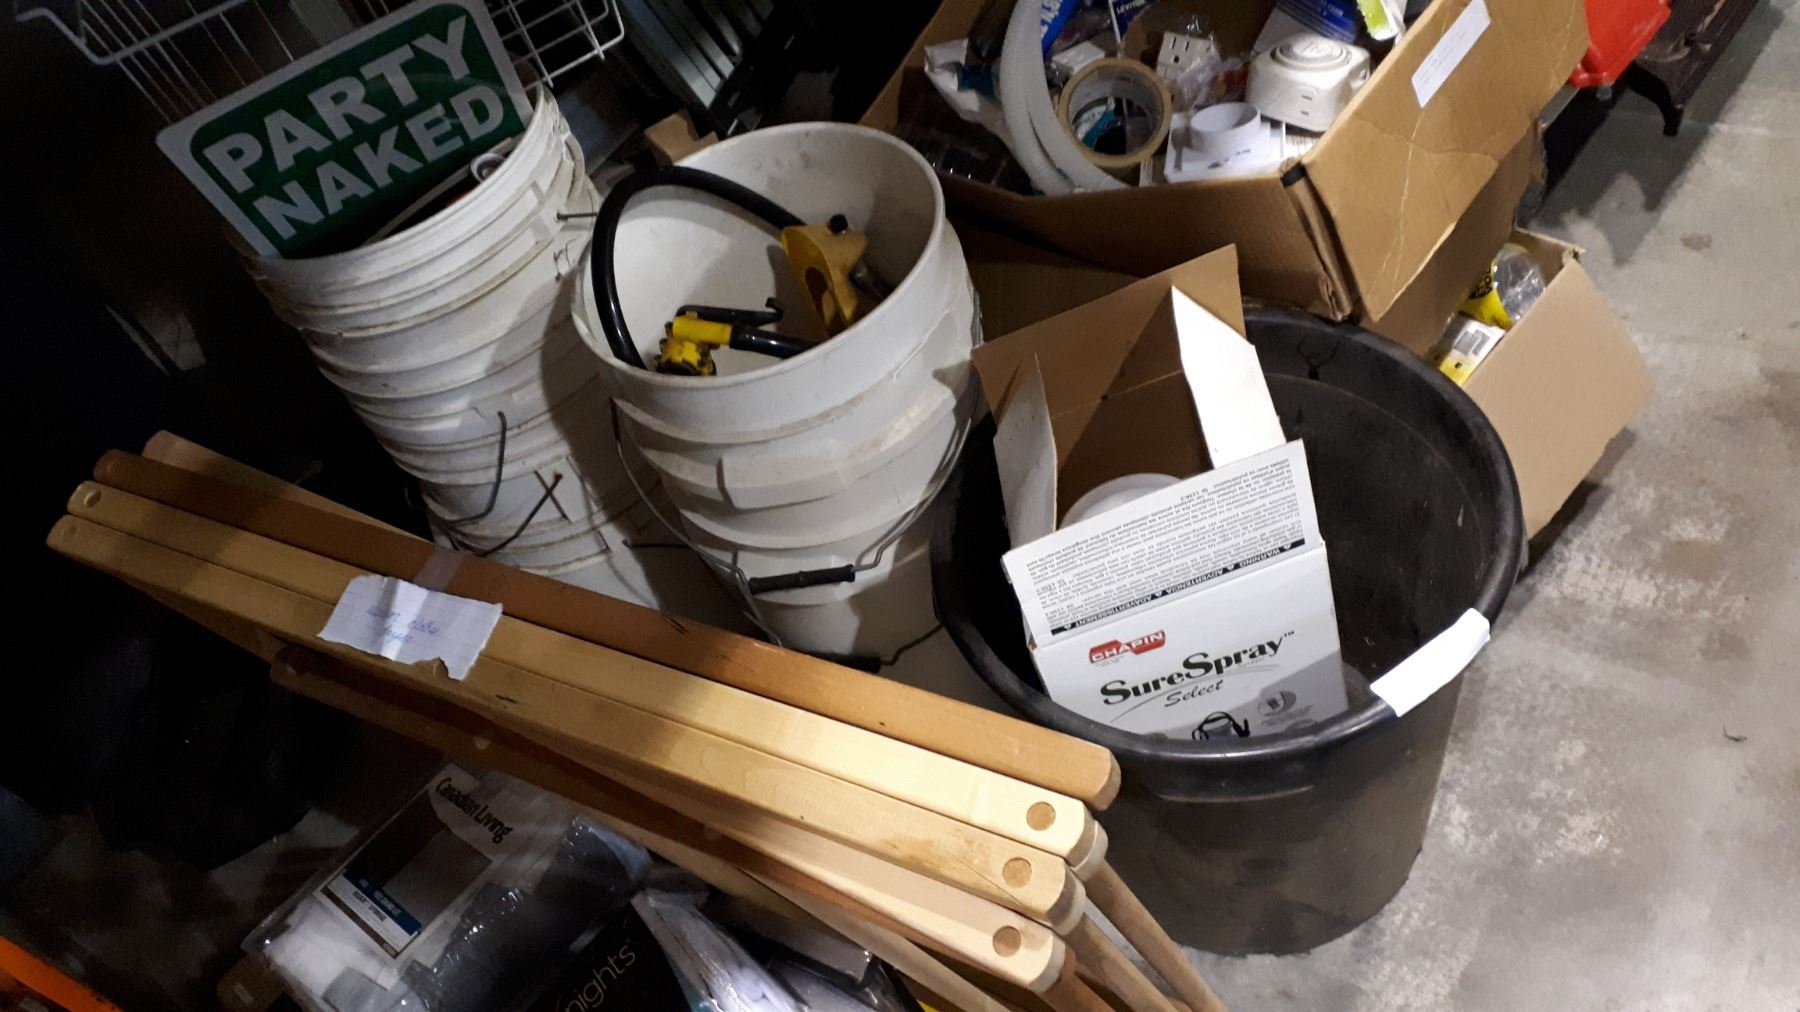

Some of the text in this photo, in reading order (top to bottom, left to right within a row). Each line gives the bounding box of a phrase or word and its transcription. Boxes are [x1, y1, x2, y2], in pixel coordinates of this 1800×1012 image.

[203, 15, 471, 194] PARTY
[252, 85, 504, 240] NAKED
[1238, 549, 1281, 568] WARNING
[1165, 568, 1224, 594] ADVERTENCIA
[1090, 630, 1165, 663] CHAPIN
[1164, 679, 1224, 708] Select
[435, 777, 514, 844] Canadian Living
